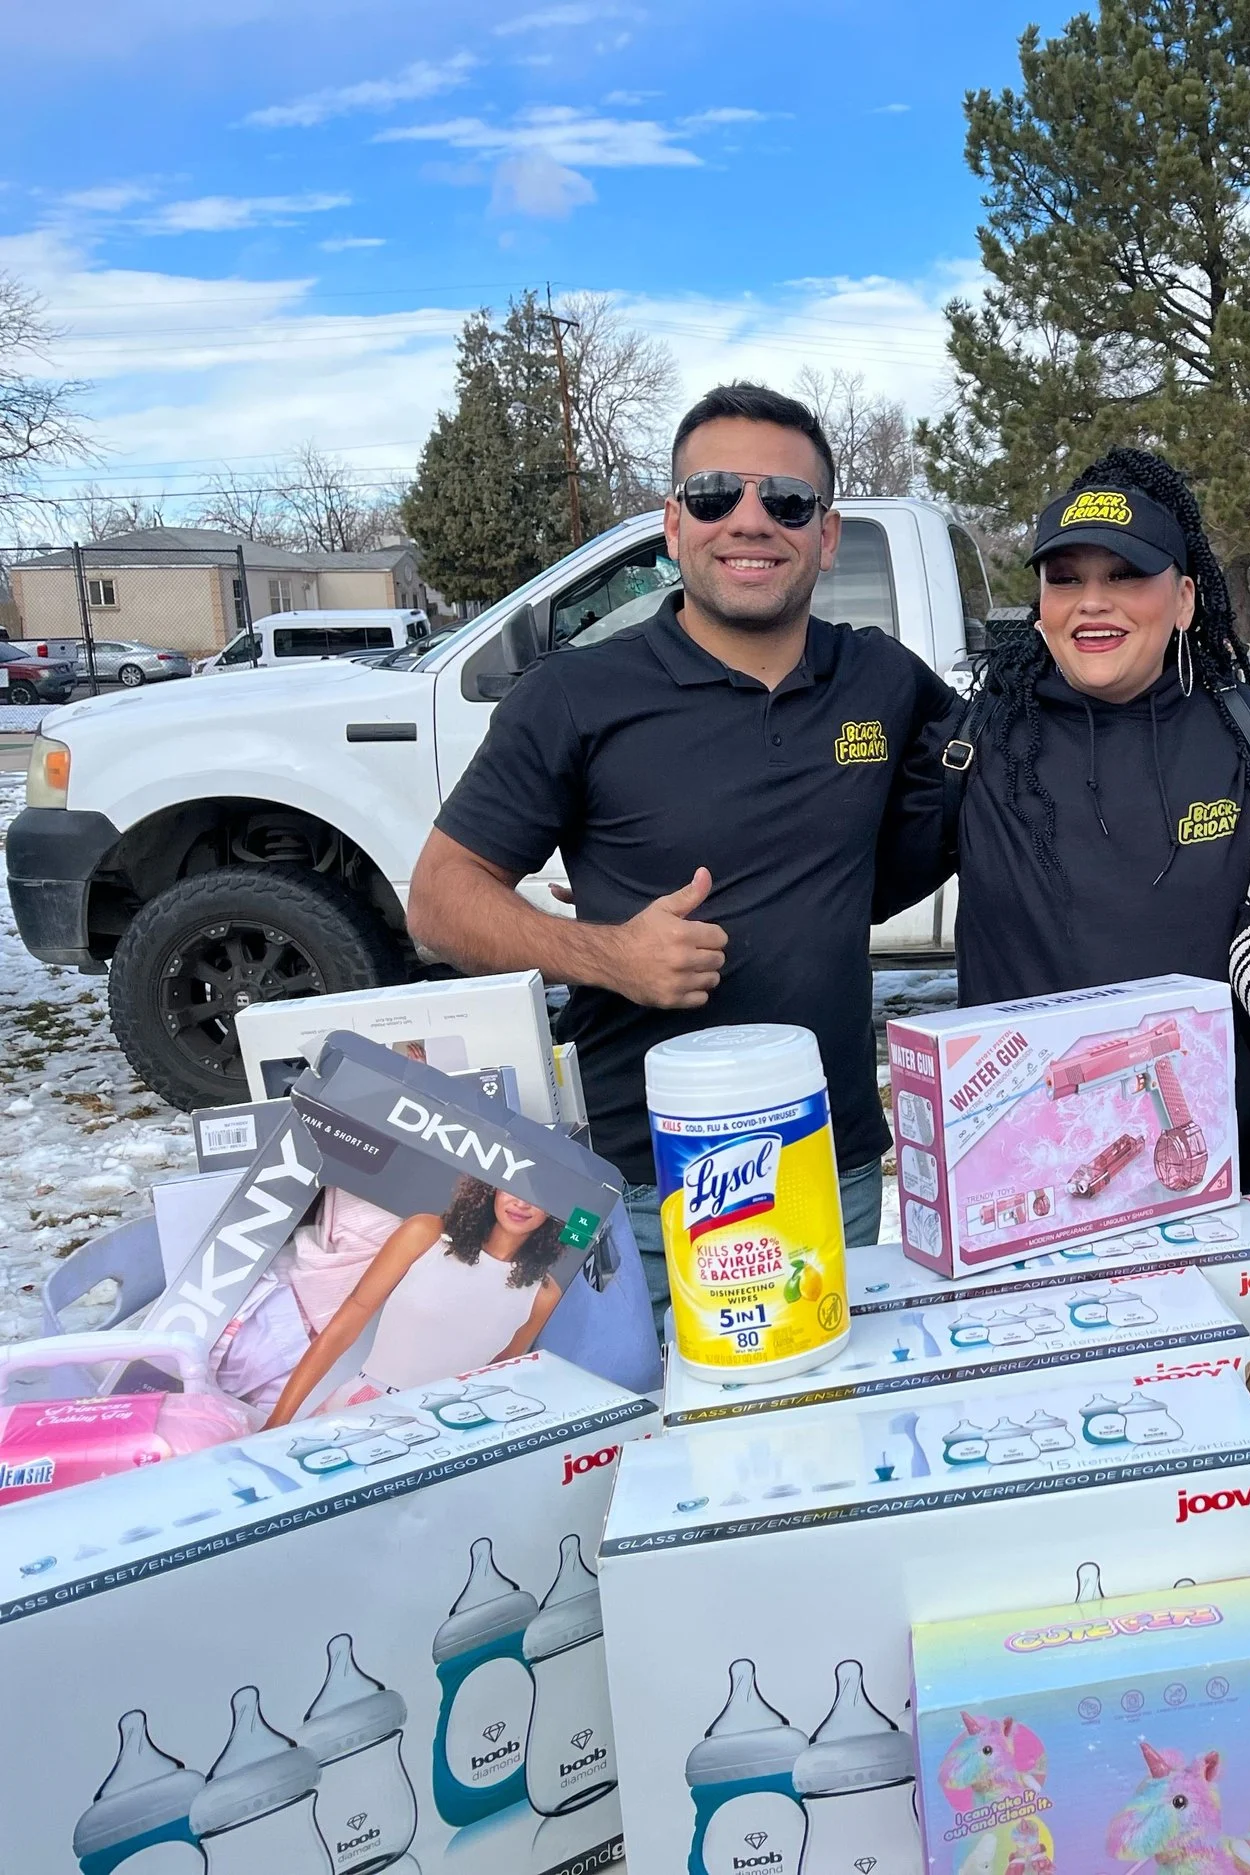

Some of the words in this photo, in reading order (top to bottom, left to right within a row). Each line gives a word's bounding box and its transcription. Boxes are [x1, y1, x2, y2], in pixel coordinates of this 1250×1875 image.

[1077, 495, 1123, 507] BLACK
[846, 725, 879, 742] BLACK
[1193, 803, 1233, 822] BLACK
[1183, 814, 1237, 840] FRIDAY
[891, 1042, 916, 1072] WATER
[916, 1050, 935, 1078] GUN
[949, 1060, 1001, 1112] WATER
[996, 1031, 1029, 1067] GUN
[301, 1112, 322, 1132] TANK
[333, 1128, 363, 1150] SHORT
[363, 1143, 380, 1157] SET
[662, 1120, 682, 1132] KILLS
[685, 1124, 705, 1134] COLD,
[707, 1122, 721, 1132] FLU
[731, 1117, 768, 1131] COVID-19
[386, 1096, 537, 1182] DKNY
[686, 1140, 773, 1215] Lysol
[998, 1186, 1016, 1197] TOYS
[577, 1216, 588, 1227] XL
[1103, 1214, 1131, 1228] UNIQUELY
[1131, 1208, 1154, 1219] SHAPED
[155, 1128, 319, 1339] DKNY
[569, 1232, 580, 1243] XL
[1029, 1233, 1055, 1247] MODERN
[1056, 1223, 1094, 1240] APPEARANCE
[696, 1244, 729, 1257] KILLS
[733, 1237, 780, 1255] 99.9%
[697, 1256, 713, 1269] OF
[718, 1246, 783, 1269] VIRUSES
[710, 1261, 783, 1281] BACTERIA
[709, 1282, 775, 1297] DISINFECTING
[727, 1294, 759, 1305] WIPES
[737, 1331, 759, 1348] 80
[455, 1353, 540, 1382] joovy
[677, 1407, 727, 1422] GLASS
[731, 1401, 766, 1414] GIFT
[979, 1351, 1081, 1376] VERRE/JUEGO
[1108, 1338, 1165, 1356] REGALO
[1190, 1327, 1237, 1342] VIDRIO
[1133, 1367, 1223, 1388] joovy
[101, 1409, 134, 1423] Toy
[54, 1579, 99, 1600] GIFT
[103, 1506, 330, 1587] SET/ENSEMBLE-CADEAU
[361, 1456, 479, 1502] VERRE/JUEGO
[506, 1428, 569, 1454] REGALO
[594, 1403, 644, 1425] VIDRIO
[617, 1533, 677, 1551] GLASS
[681, 1527, 720, 1541] GIFT
[725, 1495, 939, 1535] SET/ENSEMBLE-CADEAU
[970, 1474, 1091, 1501] VERRE/JUEGO
[1120, 1460, 1189, 1479] REGALO
[1013, 1619, 1114, 1649] CUTE
[1121, 1605, 1218, 1633] PETS
[471, 1740, 521, 1770] boob
[472, 1752, 522, 1783] diamond
[559, 1747, 608, 1777] boob
[560, 1760, 608, 1789] diamond
[943, 1827, 971, 1843] out
[972, 1818, 998, 1836] and
[999, 1803, 1036, 1823] clean
[1037, 1798, 1054, 1814] it.
[955, 1814, 963, 1826] I
[965, 1806, 990, 1824] can
[992, 1793, 1024, 1811] take
[1025, 1789, 1036, 1804] it
[336, 1827, 381, 1854] boob
[337, 1838, 382, 1864] diamond
[733, 1848, 783, 1870] boob
